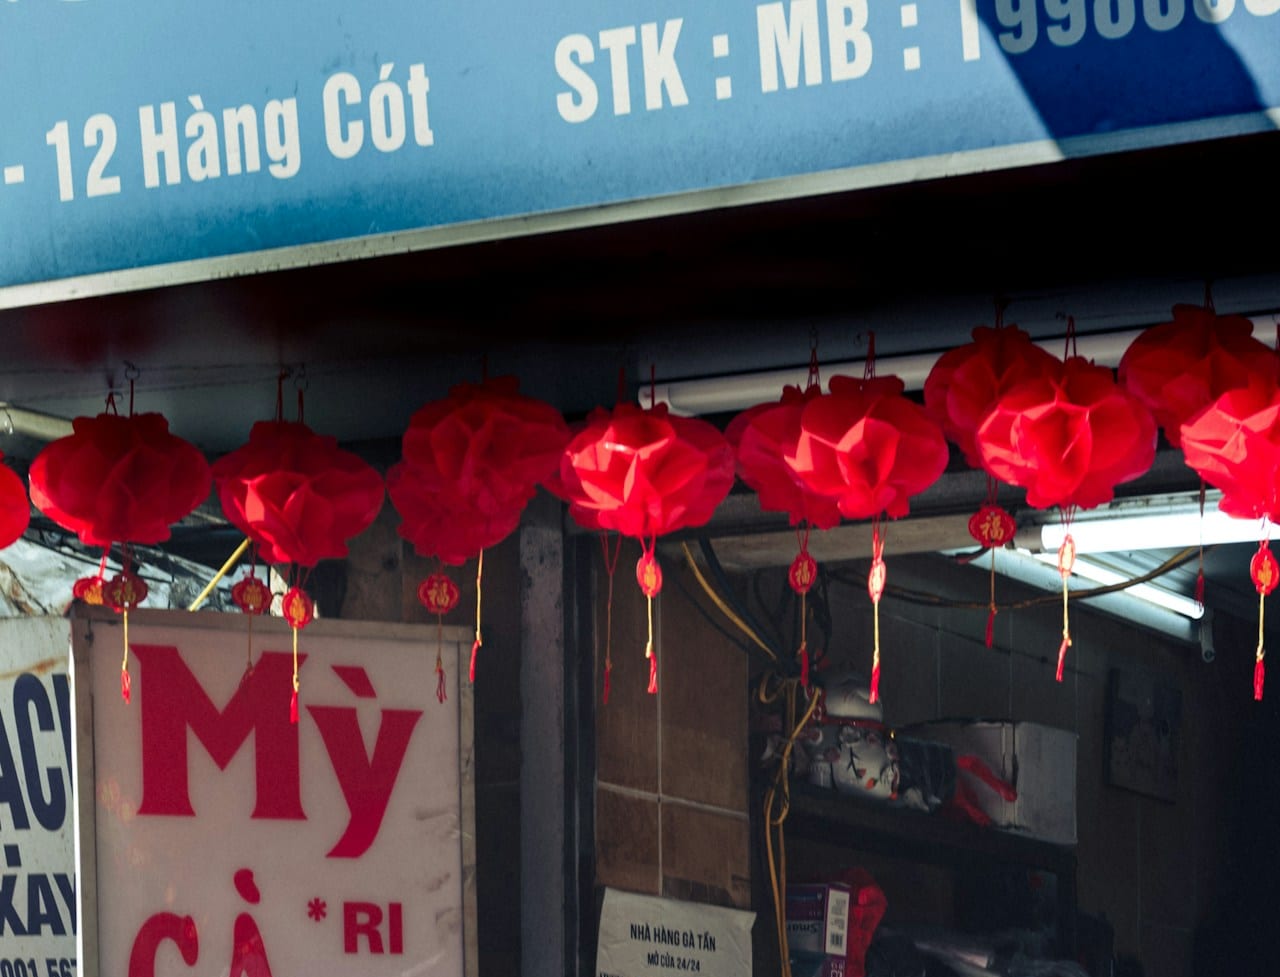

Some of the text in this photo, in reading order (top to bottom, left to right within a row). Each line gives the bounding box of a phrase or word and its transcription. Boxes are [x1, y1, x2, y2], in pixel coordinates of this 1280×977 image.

[554, 18, 689, 123] STK
[756, 0, 872, 93] MB
[46, 113, 121, 202] 12
[139, 94, 301, 188] Hàng
[322, 62, 434, 159] Cót
[129, 643, 424, 859] Mỳ
[343, 902, 403, 954] RI
[631, 923, 651, 942] NHÀ
[654, 925, 680, 946] HÀNG
[683, 930, 694, 950] GÀ
[677, 958, 700, 972] 24/24
